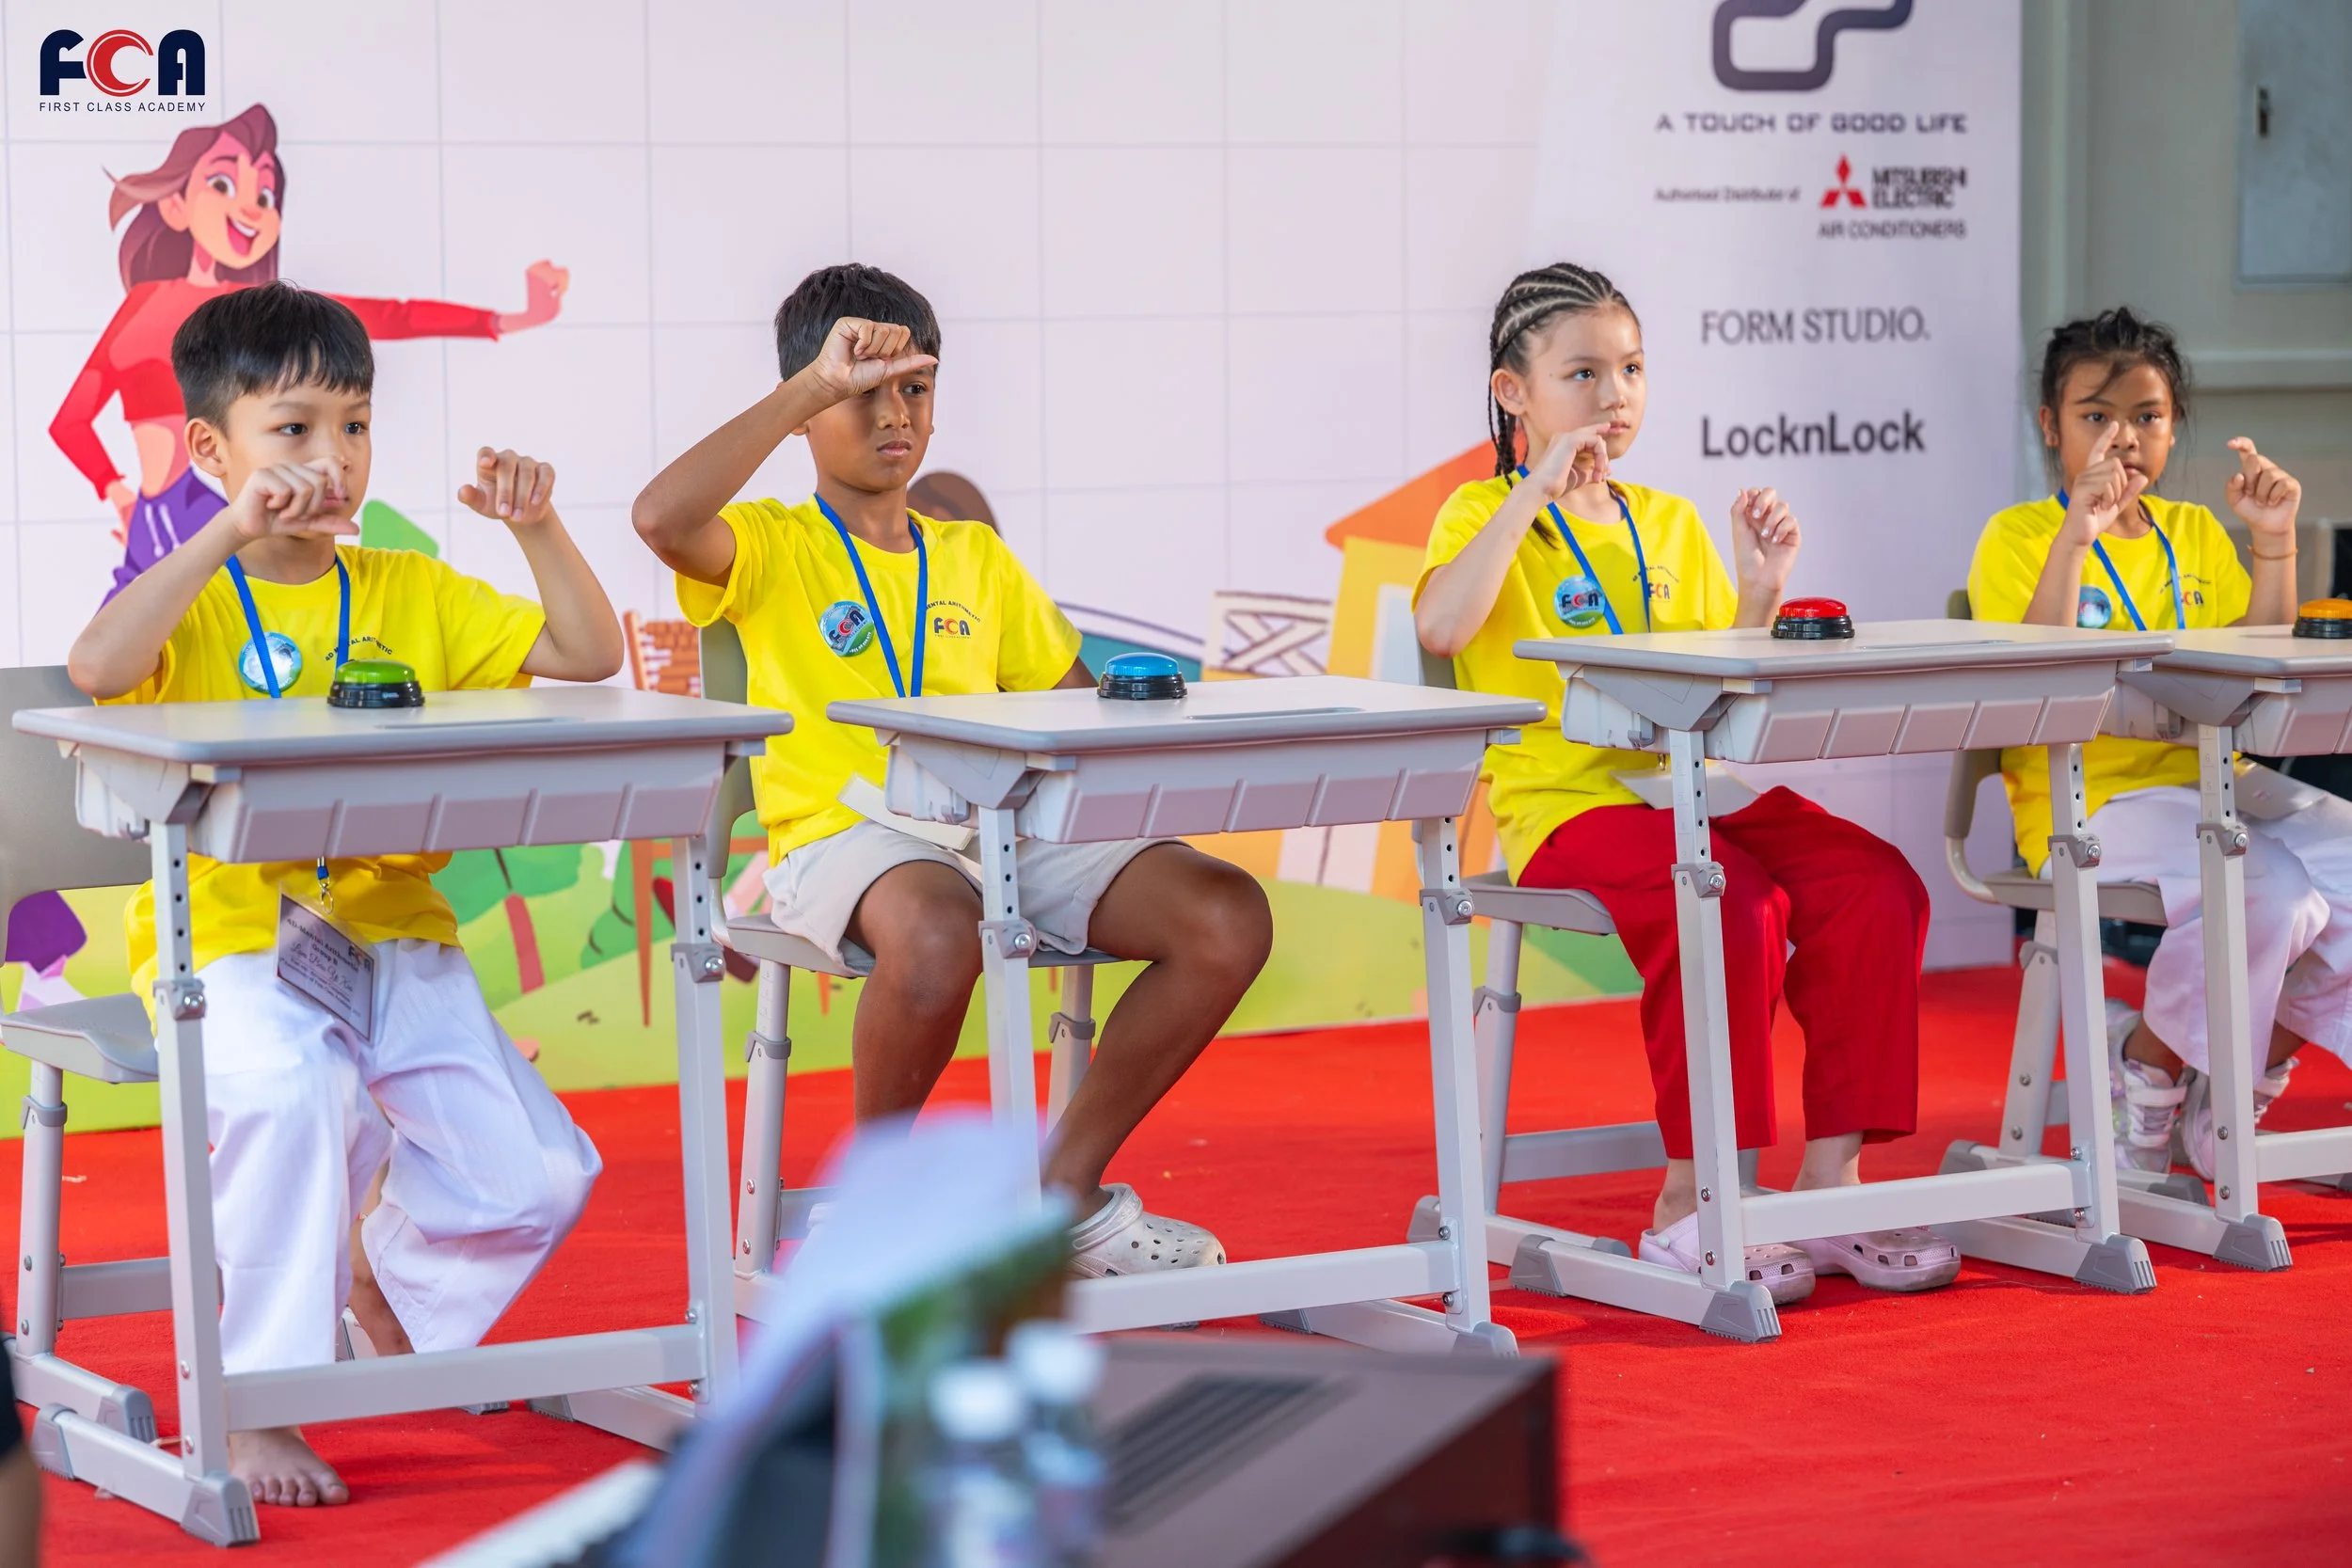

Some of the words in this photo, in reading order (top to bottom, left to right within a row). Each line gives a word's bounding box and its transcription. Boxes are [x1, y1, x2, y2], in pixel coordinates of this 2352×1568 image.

[1656, 113, 1675, 133] A
[1685, 113, 1775, 134] TOUCH
[1788, 113, 1821, 134] OF
[1831, 113, 1906, 134] GOOD
[1916, 112, 1968, 134] LIFE
[1872, 188, 1954, 209] ELECTRIC
[1819, 220, 1845, 238] AIR
[1849, 219, 1967, 238] CONDITIONERS
[1701, 309, 1794, 345] FORM
[1702, 408, 1927, 458] LocknLock
[927, 600, 946, 610] ENTAL
[933, 617, 970, 636] FCA
